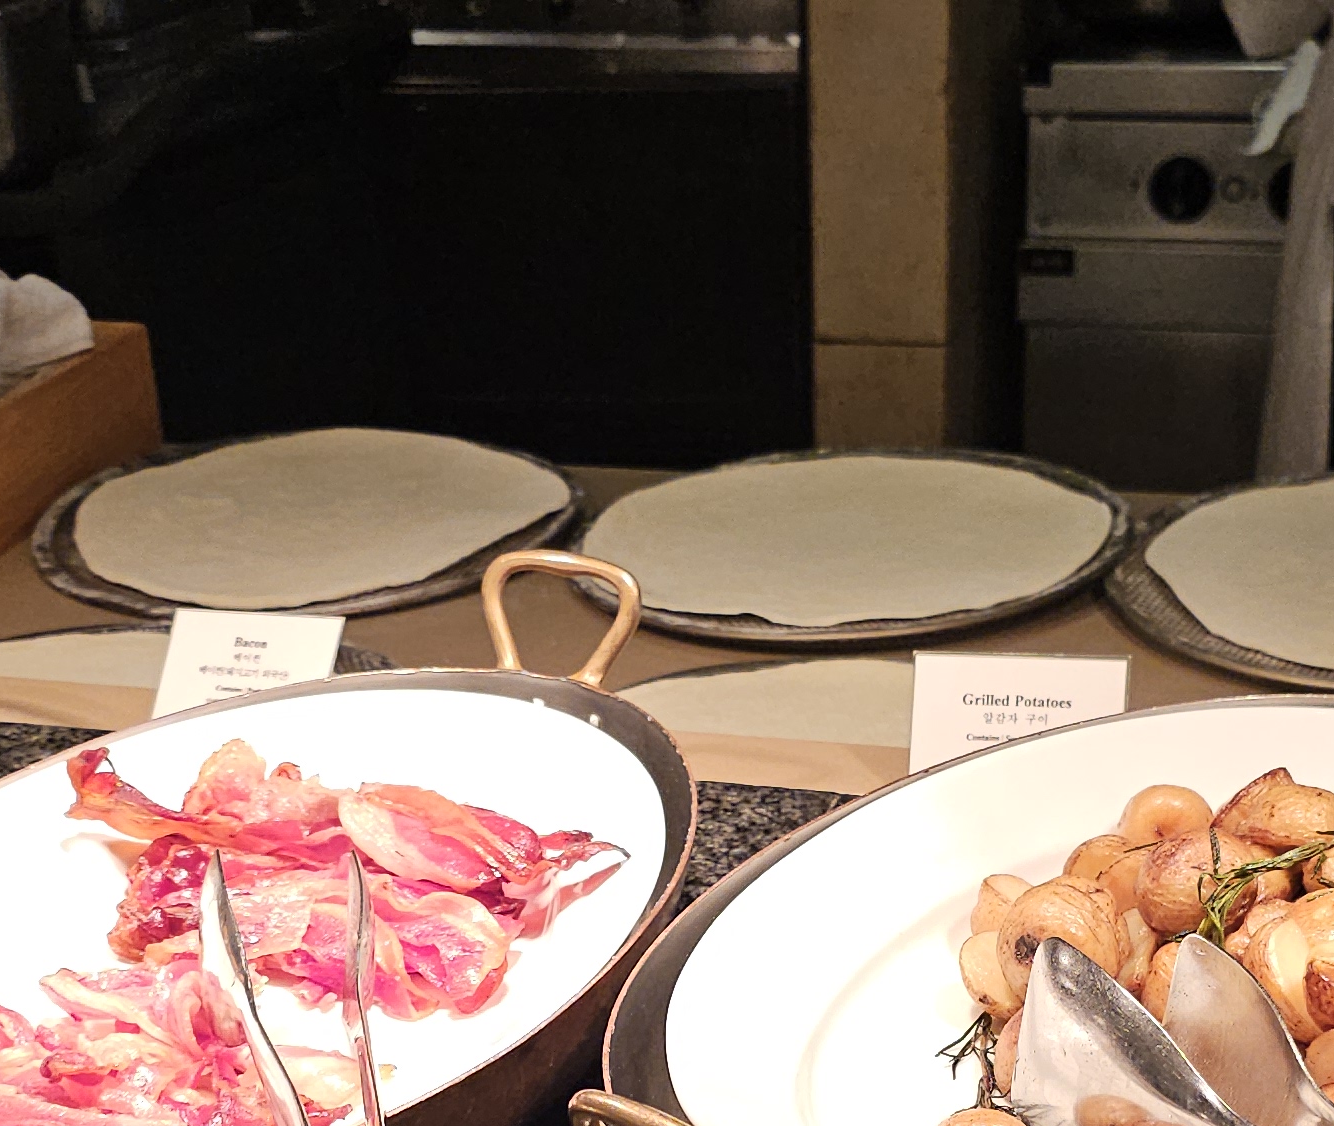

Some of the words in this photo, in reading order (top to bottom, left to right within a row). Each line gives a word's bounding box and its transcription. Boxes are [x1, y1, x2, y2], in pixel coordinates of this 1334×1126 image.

[233, 636, 268, 649] Bacon
[962, 693, 1010, 707] Grilled
[1014, 694, 1073, 709] Potatoes
[983, 711, 1019, 725] 알감자
[1025, 713, 1049, 727] 구이
